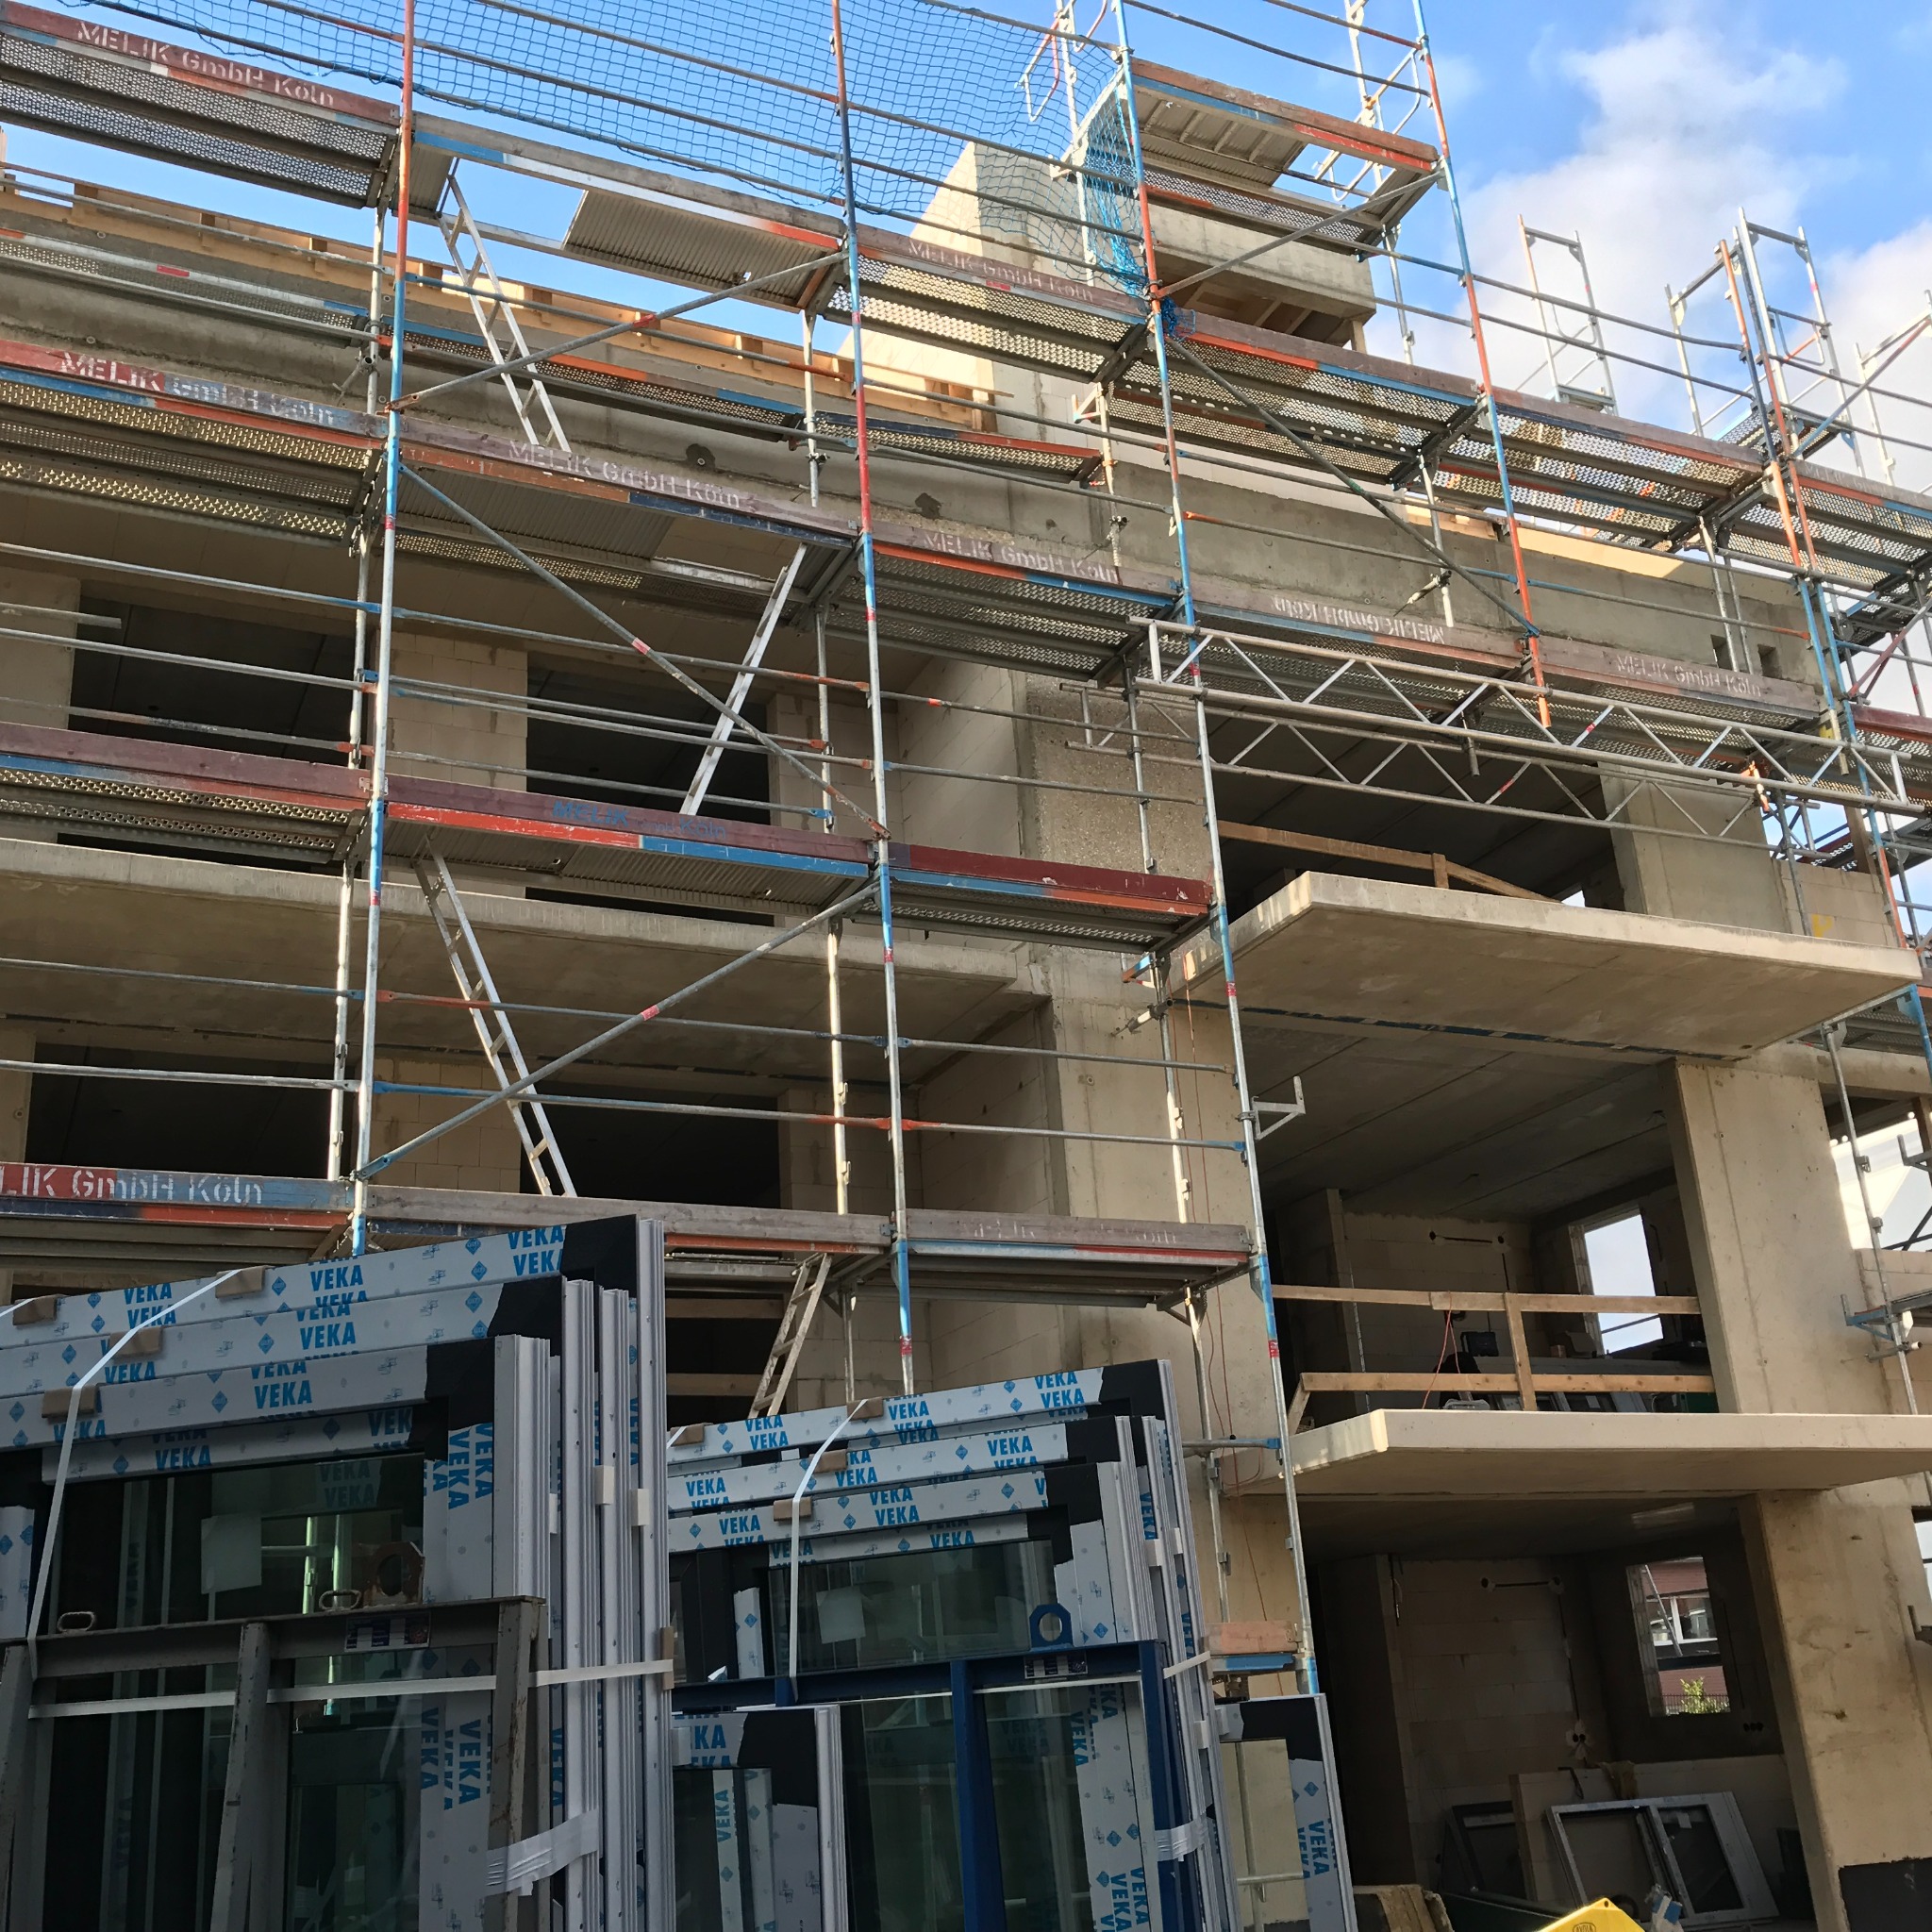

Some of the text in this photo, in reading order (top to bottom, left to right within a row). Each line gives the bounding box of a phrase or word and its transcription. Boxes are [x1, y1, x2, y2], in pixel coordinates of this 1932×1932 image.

[77, 20, 171, 61] MELIK
[181, 50, 264, 89] GmbH
[60, 350, 162, 391] MELIK
[508, 440, 592, 476] MELIK
[551, 800, 630, 828] MELIK
[678, 816, 727, 840] Köln
[188, 1173, 263, 1206] Köln
[508, 1224, 565, 1250] VEKA
[310, 1264, 364, 1292] VEKA
[124, 1282, 173, 1306] VEKA
[300, 1322, 357, 1351] VEKA
[104, 1360, 157, 1385] VEKA
[1035, 1371, 1078, 1391] VEKA
[254, 1380, 313, 1409] VEKA
[1041, 1388, 1086, 1410] VEKA
[367, 1407, 413, 1437] VEK
[745, 1415, 784, 1433] VEKA
[889, 1401, 930, 1421] VEKA
[750, 1430, 790, 1451] VEKA
[987, 1435, 1034, 1457] VEKA
[155, 1444, 212, 1472] VEKA
[448, 1429, 470, 1510] VEKA
[475, 1424, 493, 1500] VEKA
[686, 1477, 727, 1497] VEKA
[835, 1466, 878, 1489] VEKA
[869, 1488, 914, 1507] VEKA
[719, 1514, 761, 1536] VEKA
[874, 1505, 921, 1526] VEKA
[772, 1540, 814, 1560] VEA
[930, 1530, 975, 1550] VEKA
[422, 1707, 440, 1790] VEKA
[694, 1724, 726, 1750] KA
[1071, 1710, 1090, 1767] VEKA
[458, 1718, 482, 1806] VEKA
[715, 1790, 732, 1842] VEKA
[1309, 1820, 1330, 1875] VEKA
[1110, 1873, 1132, 1932] VEKA
[1130, 1866, 1150, 1925] VEKA
